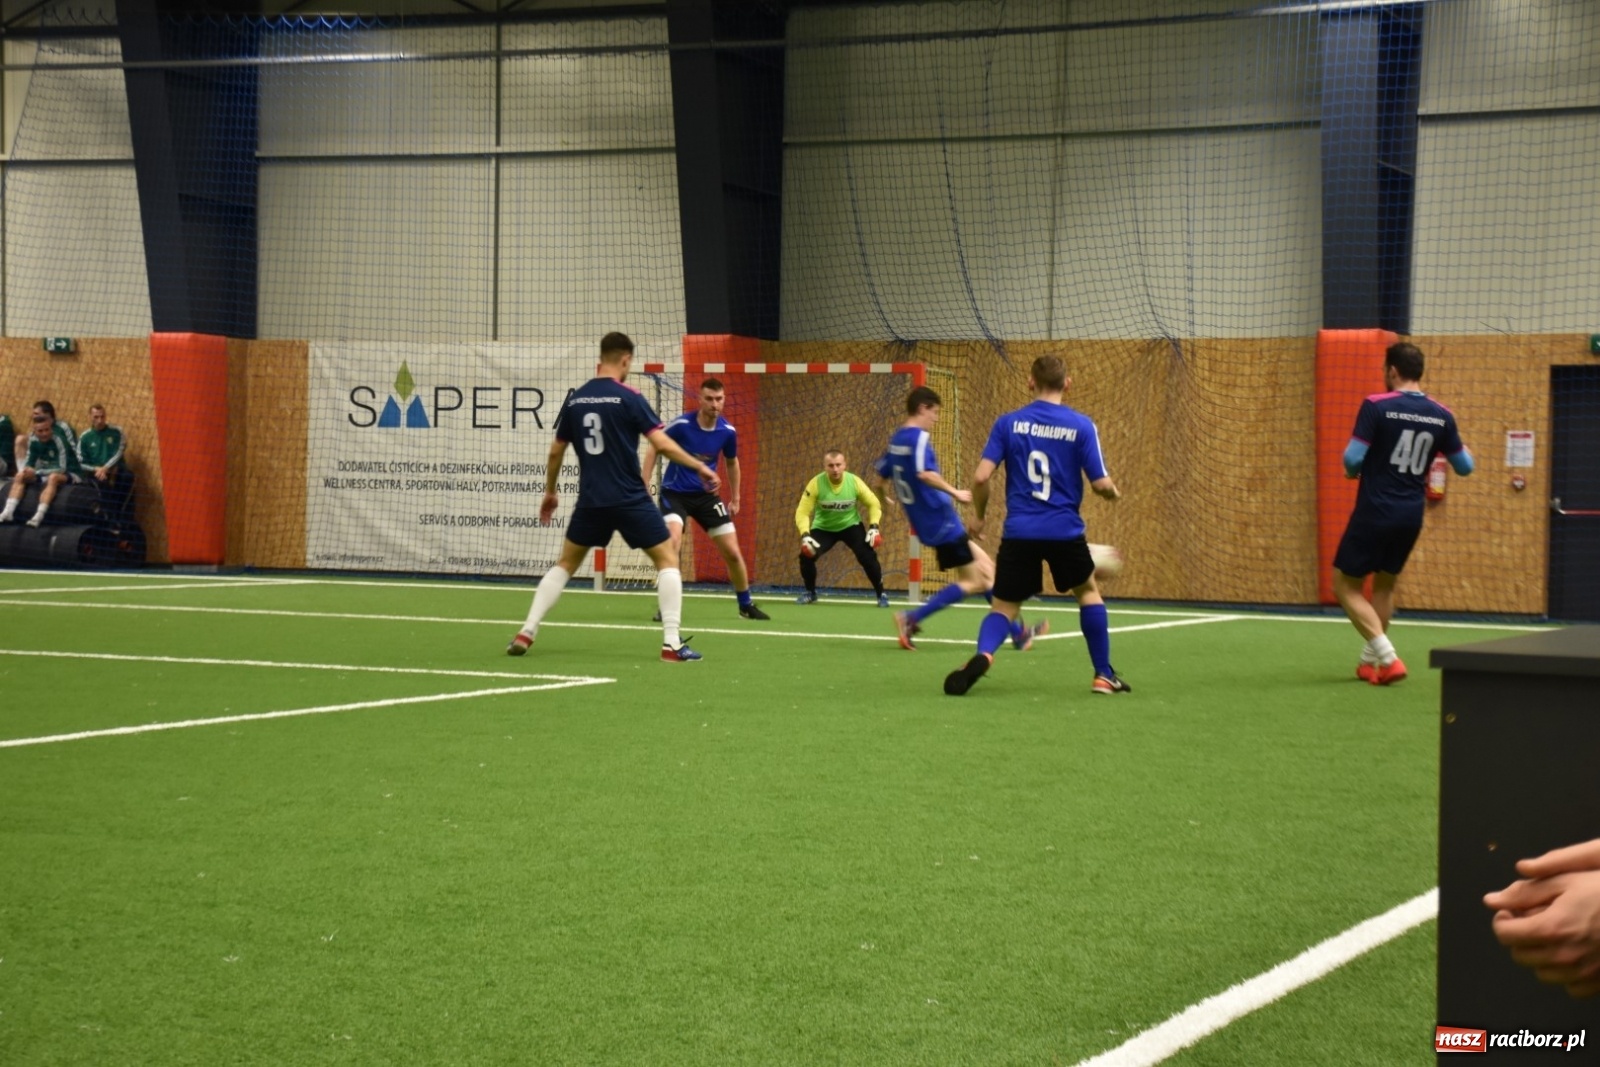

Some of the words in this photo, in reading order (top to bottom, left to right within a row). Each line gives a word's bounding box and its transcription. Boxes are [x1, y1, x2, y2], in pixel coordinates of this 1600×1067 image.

[1385, 411, 1398, 419] LKS
[582, 412, 605, 455] 3
[1013, 420, 1031, 435] LKS
[1031, 423, 1078, 442] CHAŁUPKI
[1389, 428, 1434, 476] 40
[338, 461, 387, 473] DODAVATEL
[432, 463, 437, 473] A
[440, 462, 508, 475] DEZINFEKČNÍCH
[562, 465, 580, 477] PRO
[1027, 449, 1051, 502] 9
[324, 478, 367, 489] WELLNESS
[368, 479, 404, 491] CENTRA,
[406, 478, 456, 491] SPORTOVNÍ
[457, 481, 480, 492] HALY,
[556, 482, 562, 493] A
[892, 464, 915, 505] 6
[713, 502, 728, 518] 17
[419, 514, 448, 526] SERVIS
[450, 515, 456, 526] A
[457, 514, 501, 528] ODBORNÉ
